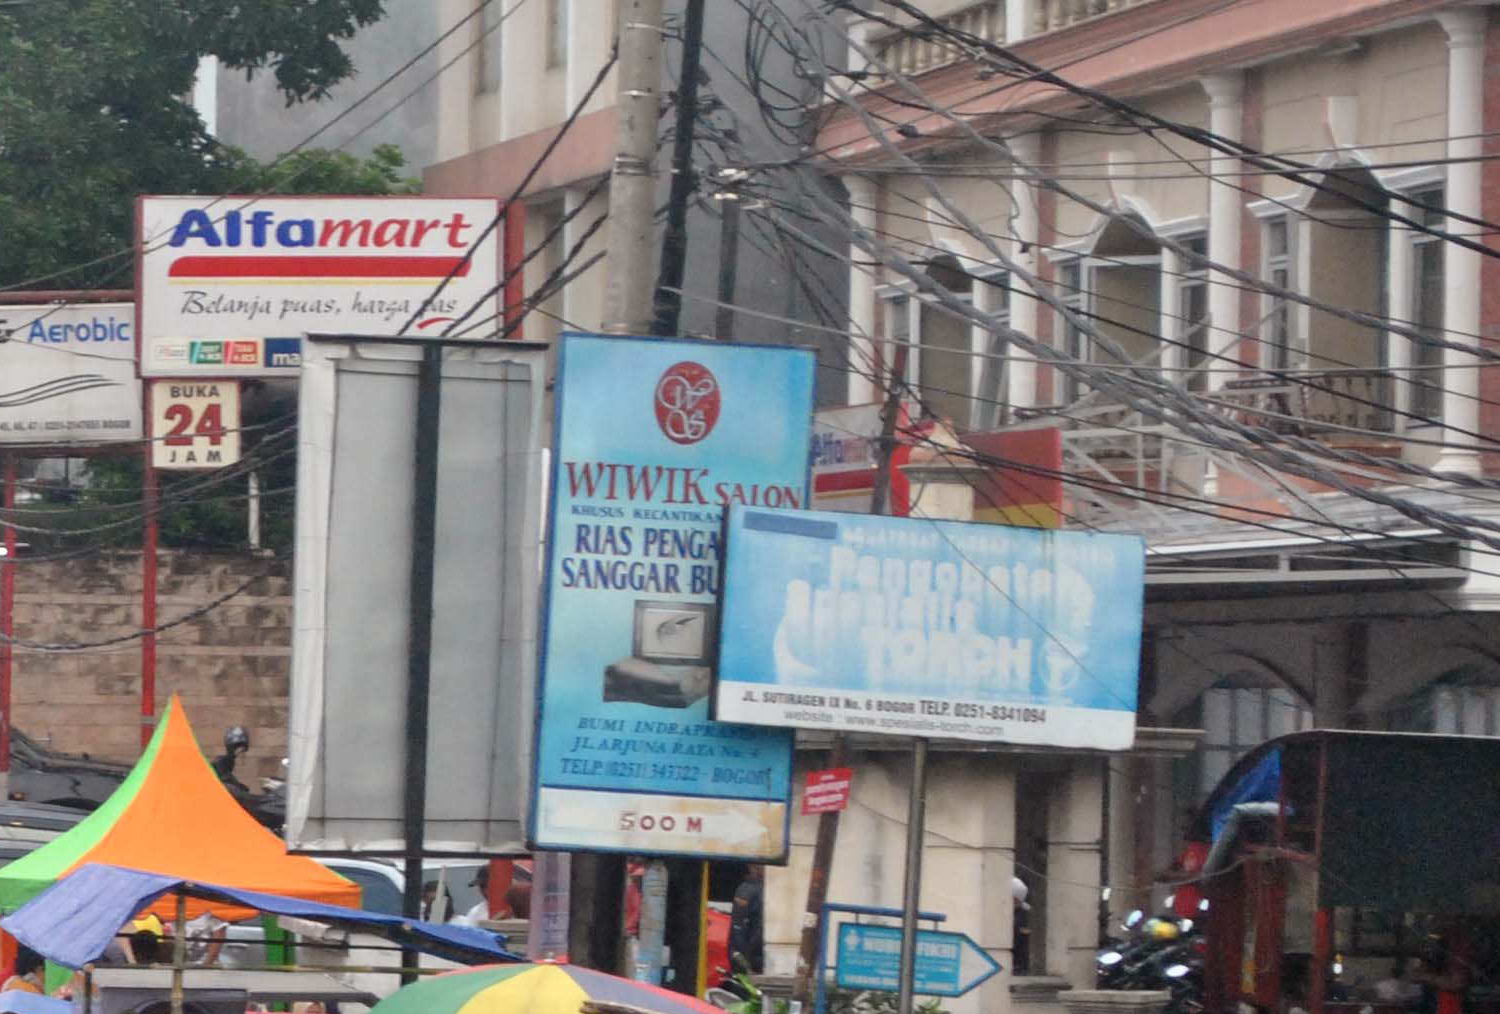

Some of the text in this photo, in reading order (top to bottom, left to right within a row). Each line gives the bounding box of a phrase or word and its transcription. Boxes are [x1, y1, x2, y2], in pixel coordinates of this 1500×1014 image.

[168, 209, 472, 247] Alfamart
[180, 290, 272, 319] Belanja
[28, 318, 130, 343] Aerobic
[170, 384, 219, 398] BUKA
[163, 404, 227, 446] 24
[564, 461, 710, 505] WIWIK
[571, 504, 624, 518] KHUSUS
[574, 523, 632, 556] RIAS
[561, 558, 682, 594] SANGGAR
[686, 816, 703, 833] M
